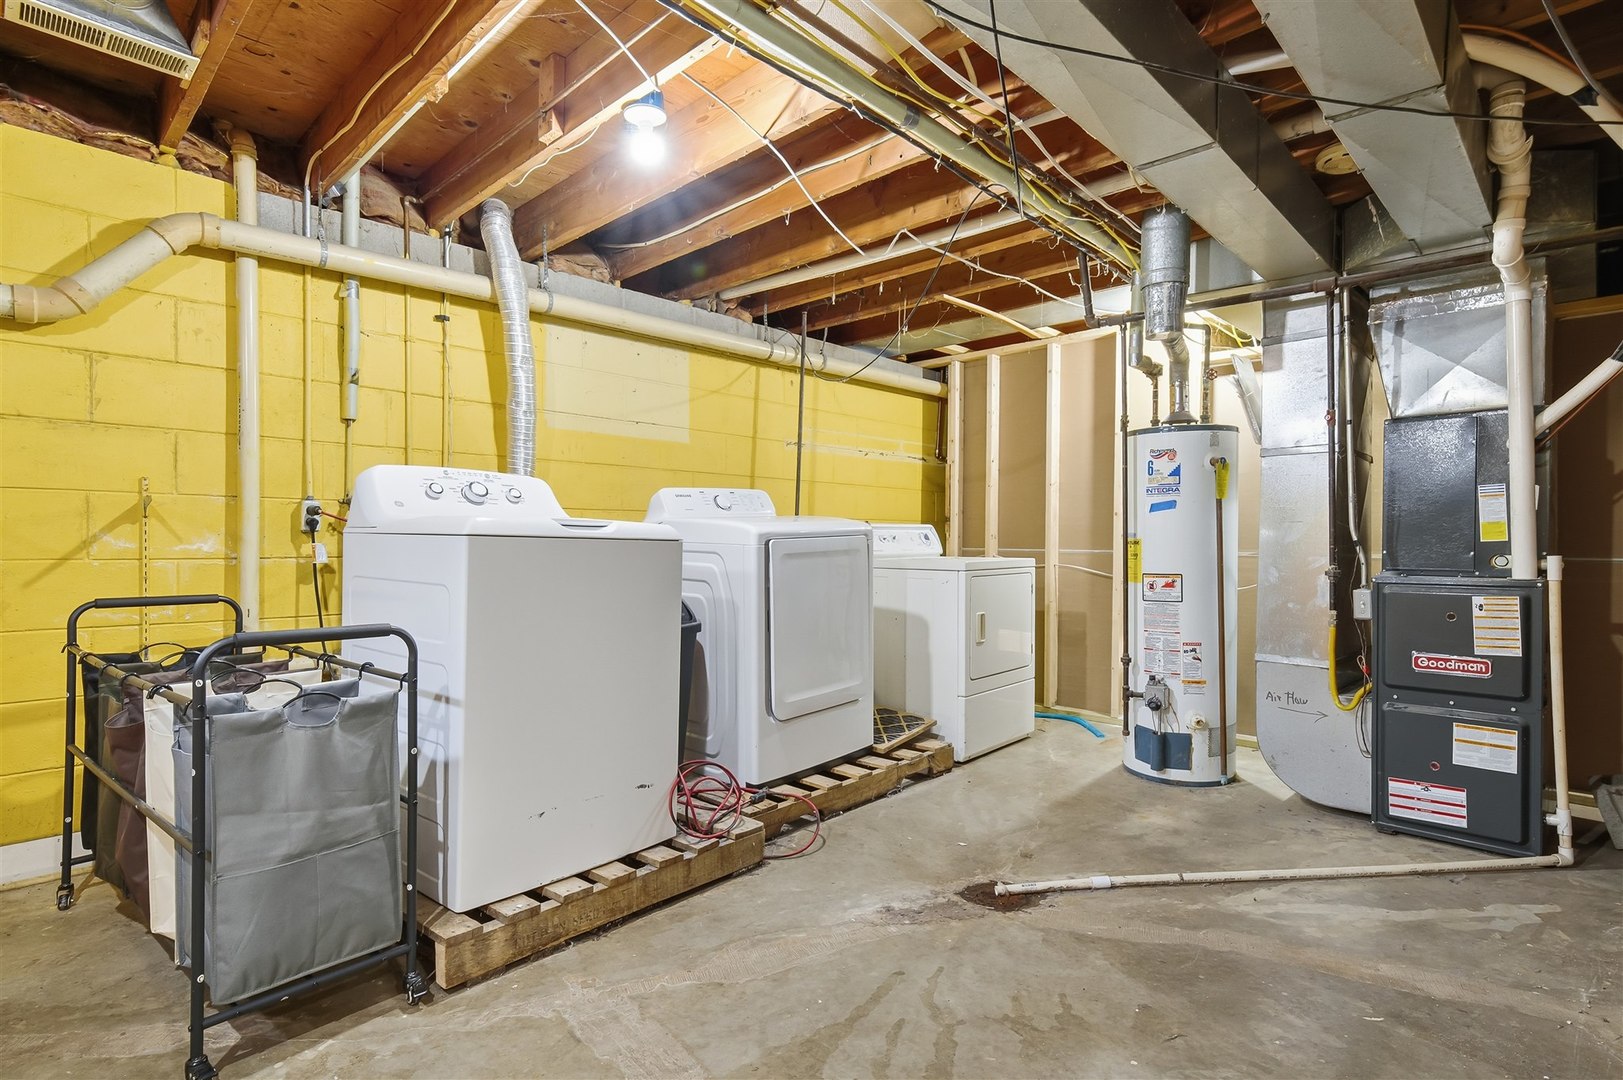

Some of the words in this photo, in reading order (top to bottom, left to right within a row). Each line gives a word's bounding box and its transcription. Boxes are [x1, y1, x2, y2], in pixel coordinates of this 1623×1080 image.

[1147, 460, 1154, 476] 6
[1417, 657, 1486, 673] Goodman
[1265, 690, 1282, 702] Air
[1284, 691, 1309, 705] Flow
